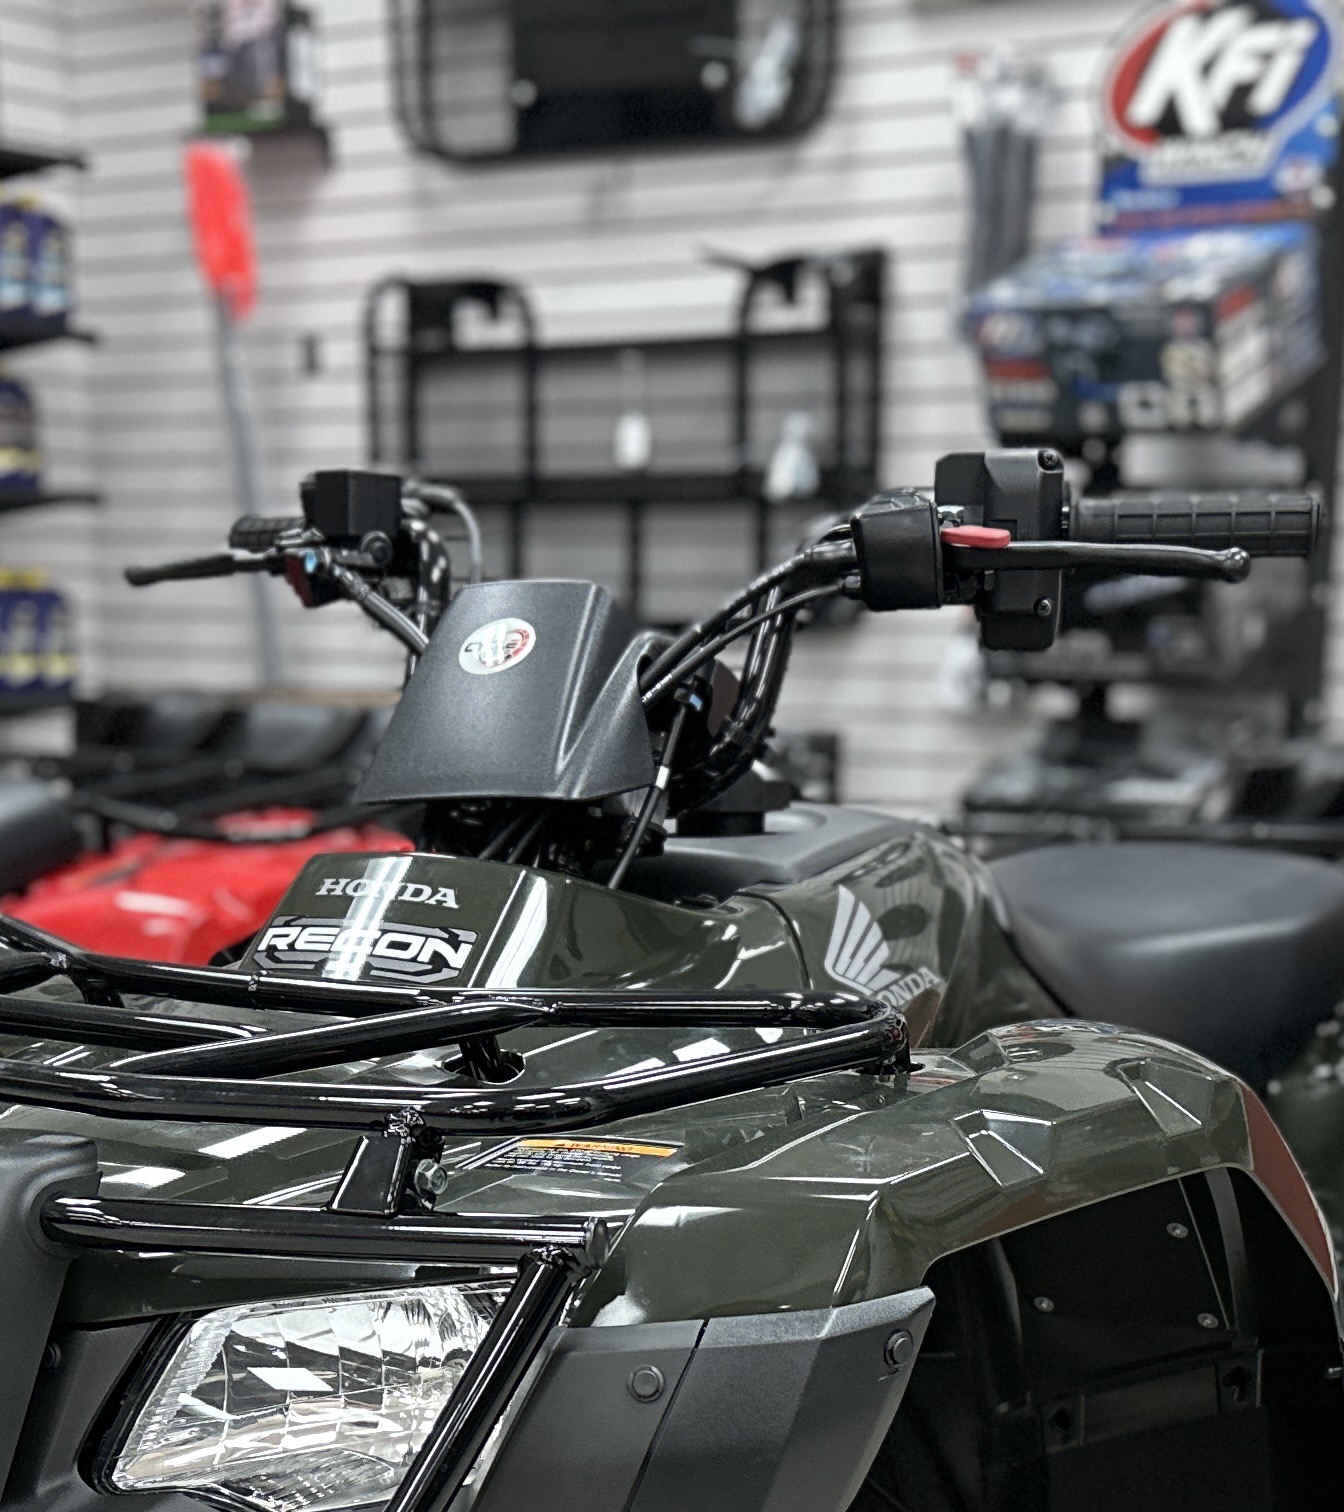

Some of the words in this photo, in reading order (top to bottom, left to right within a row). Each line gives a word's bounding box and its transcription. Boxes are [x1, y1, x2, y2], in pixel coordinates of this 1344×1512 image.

[1125, 6, 1317, 139] KFI
[315, 878, 459, 909] HONDA
[257, 926, 473, 969] RECON
[876, 966, 941, 1007] ONDA
